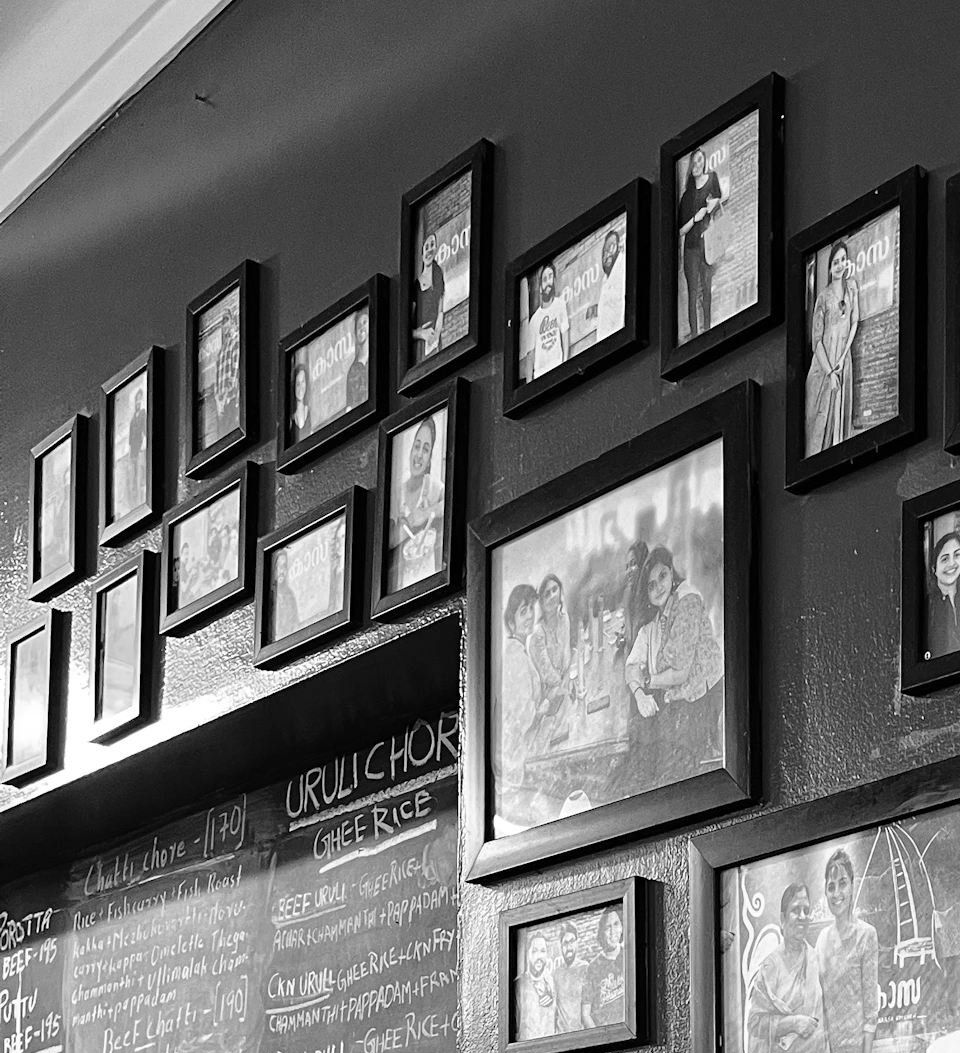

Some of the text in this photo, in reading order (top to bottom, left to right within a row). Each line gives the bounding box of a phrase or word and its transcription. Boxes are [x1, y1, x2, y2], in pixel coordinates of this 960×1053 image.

[286, 752, 358, 818] URULI
[314, 789, 432, 860] GHEE RICE
[278, 891, 312, 921] BEEF
[268, 972, 296, 999] CKN
[404, 1012, 439, 1048] RICE
